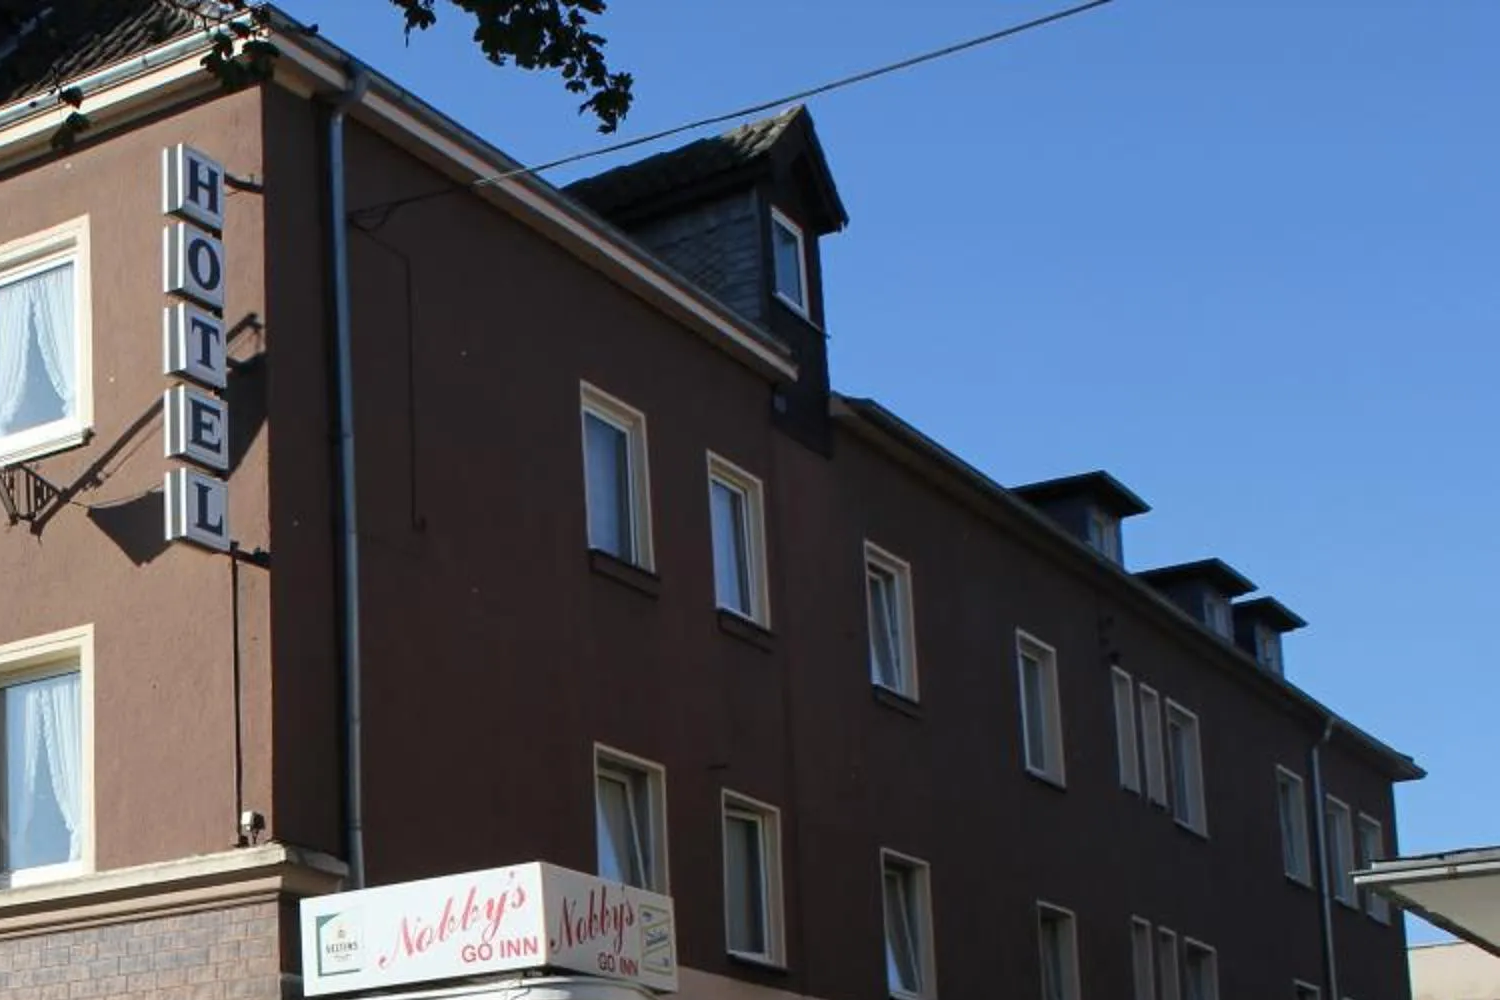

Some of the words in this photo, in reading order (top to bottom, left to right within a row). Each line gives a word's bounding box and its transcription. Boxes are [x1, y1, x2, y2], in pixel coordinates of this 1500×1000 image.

[187, 154, 225, 538] HOTEL
[377, 870, 526, 969] Nobby's
[461, 943, 493, 963] GO
[500, 936, 538, 959] INN
[549, 884, 635, 955] Nobby's
[598, 951, 616, 973] GO
[619, 955, 638, 977] INN
